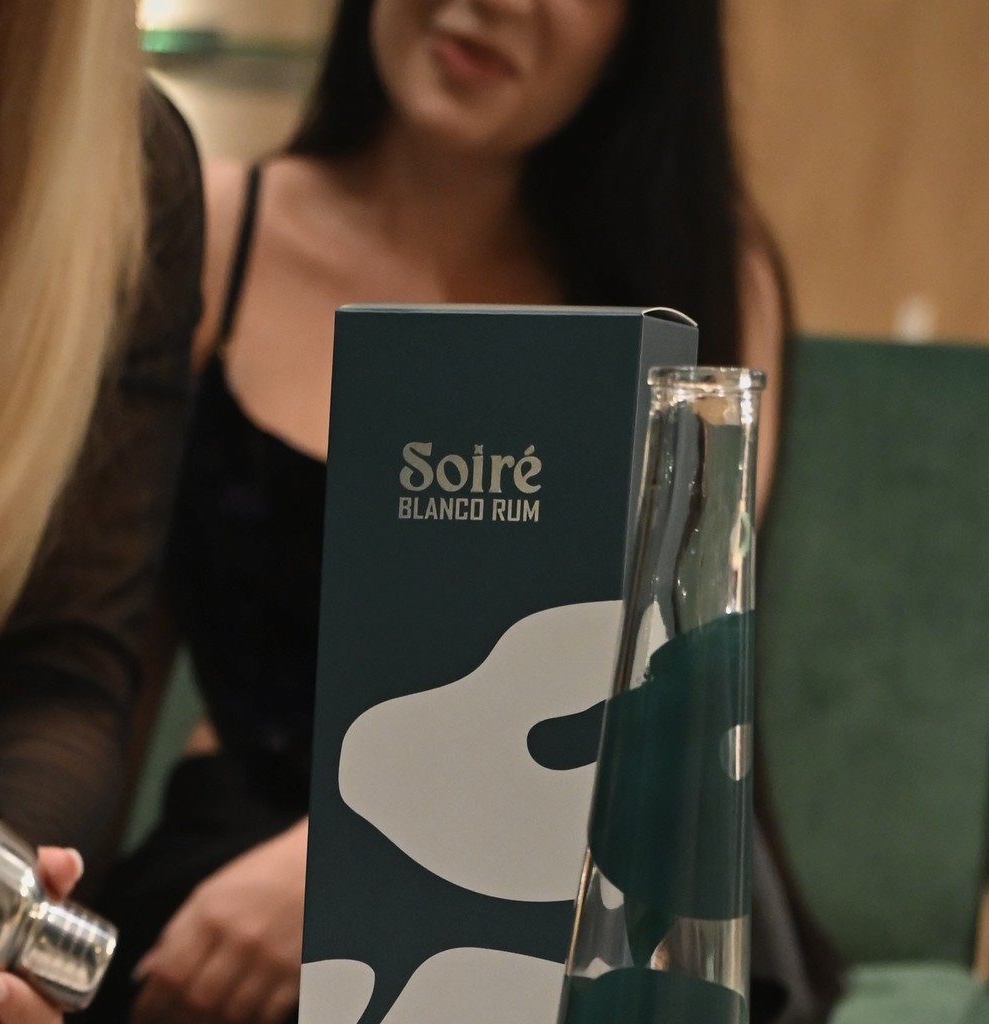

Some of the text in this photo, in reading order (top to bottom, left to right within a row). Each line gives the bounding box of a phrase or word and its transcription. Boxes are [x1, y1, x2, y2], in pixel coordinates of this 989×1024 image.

[399, 441, 542, 494] Soiré
[398, 496, 540, 523] BLANCO RUM
